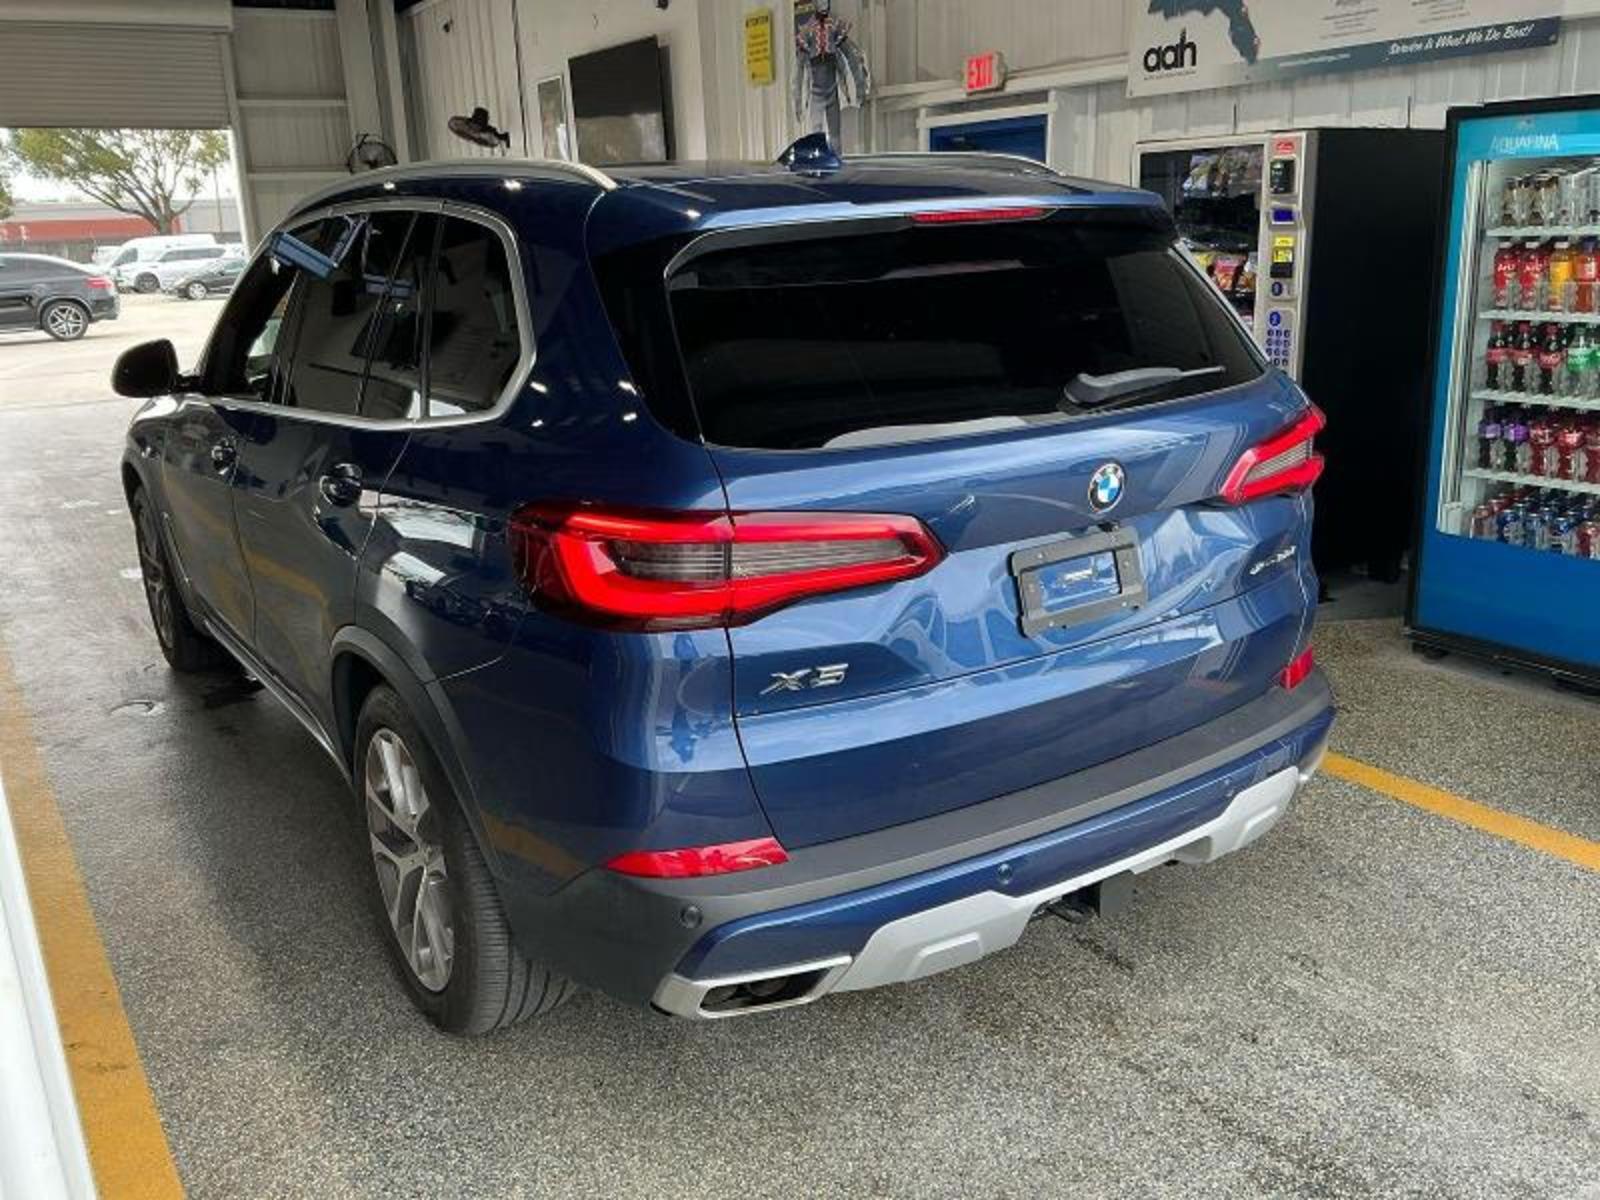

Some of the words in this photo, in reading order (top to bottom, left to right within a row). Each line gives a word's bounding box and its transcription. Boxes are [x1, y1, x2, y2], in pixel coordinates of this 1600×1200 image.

[1143, 27, 1197, 72] aah
[1435, 34, 1464, 48] What
[1484, 28, 1501, 41] Do
[967, 56, 992, 88] EXIT
[1489, 132, 1559, 155] AQUAFINA
[759, 663, 849, 695] X5
